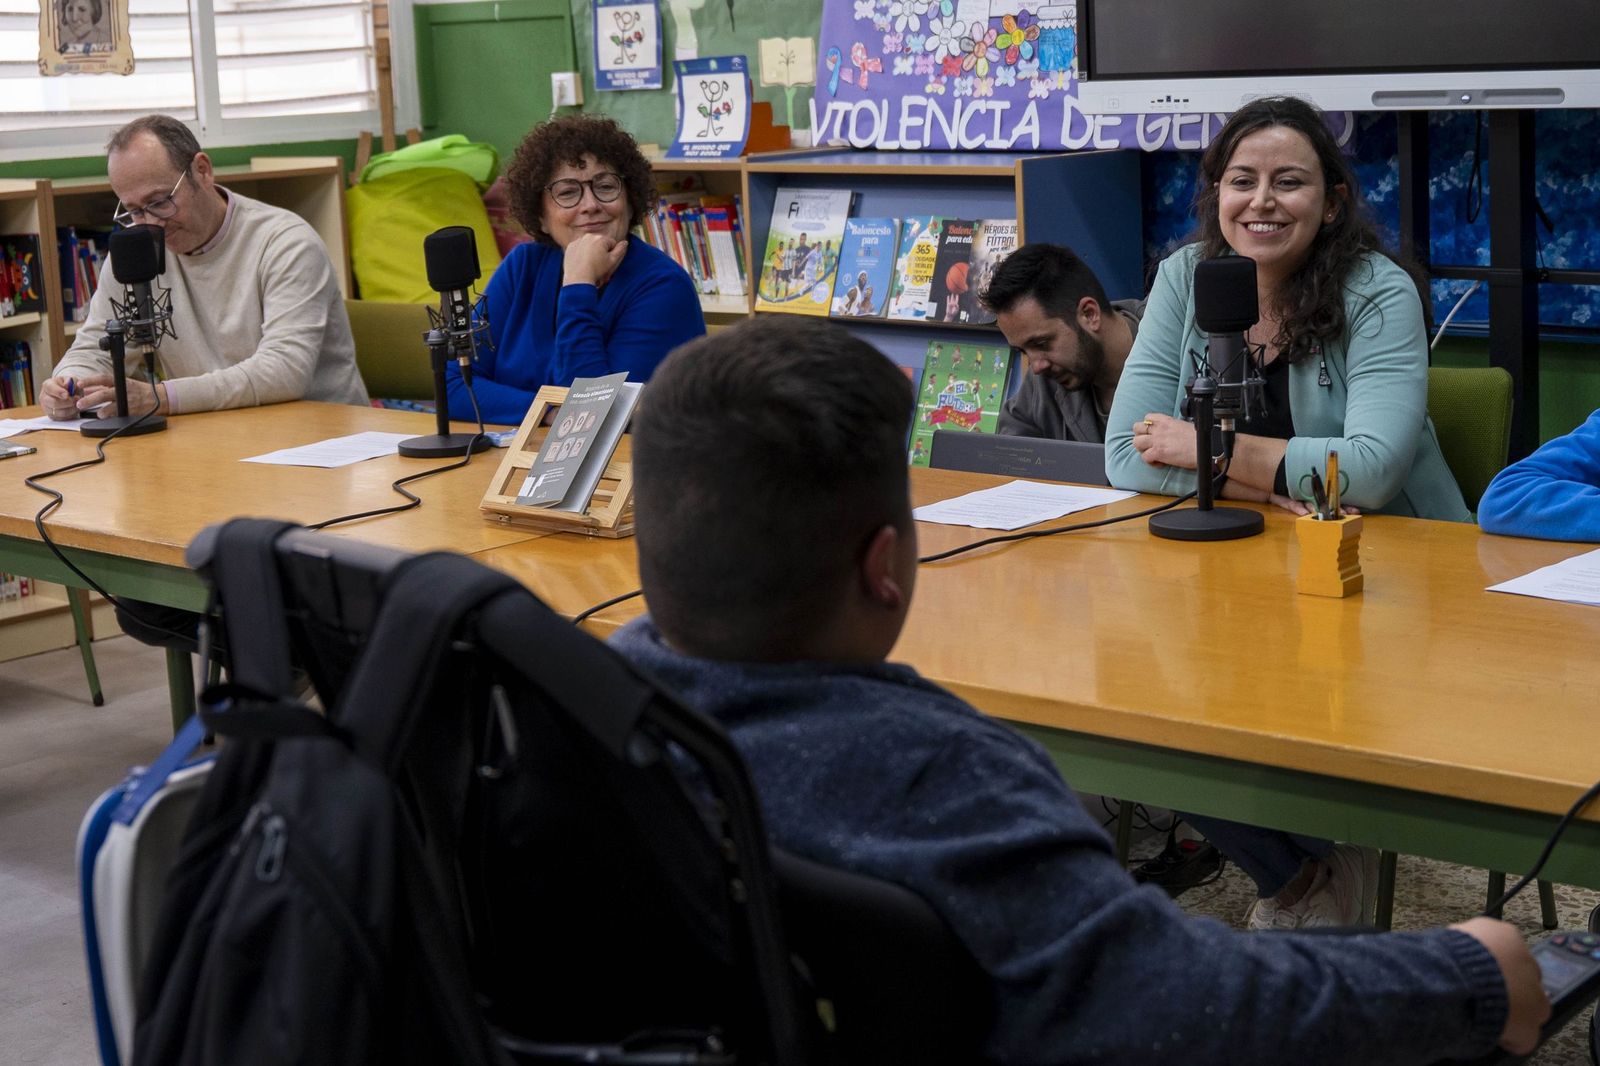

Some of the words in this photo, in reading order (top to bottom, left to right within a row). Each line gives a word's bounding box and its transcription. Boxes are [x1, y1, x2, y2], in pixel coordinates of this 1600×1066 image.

[808, 95, 1040, 150] VIOLENCIA
[1061, 95, 1122, 150] DE
[852, 225, 891, 235] Baloncesto
[862, 236, 878, 246] para
[945, 235, 962, 244] para
[916, 244, 931, 255] 365
